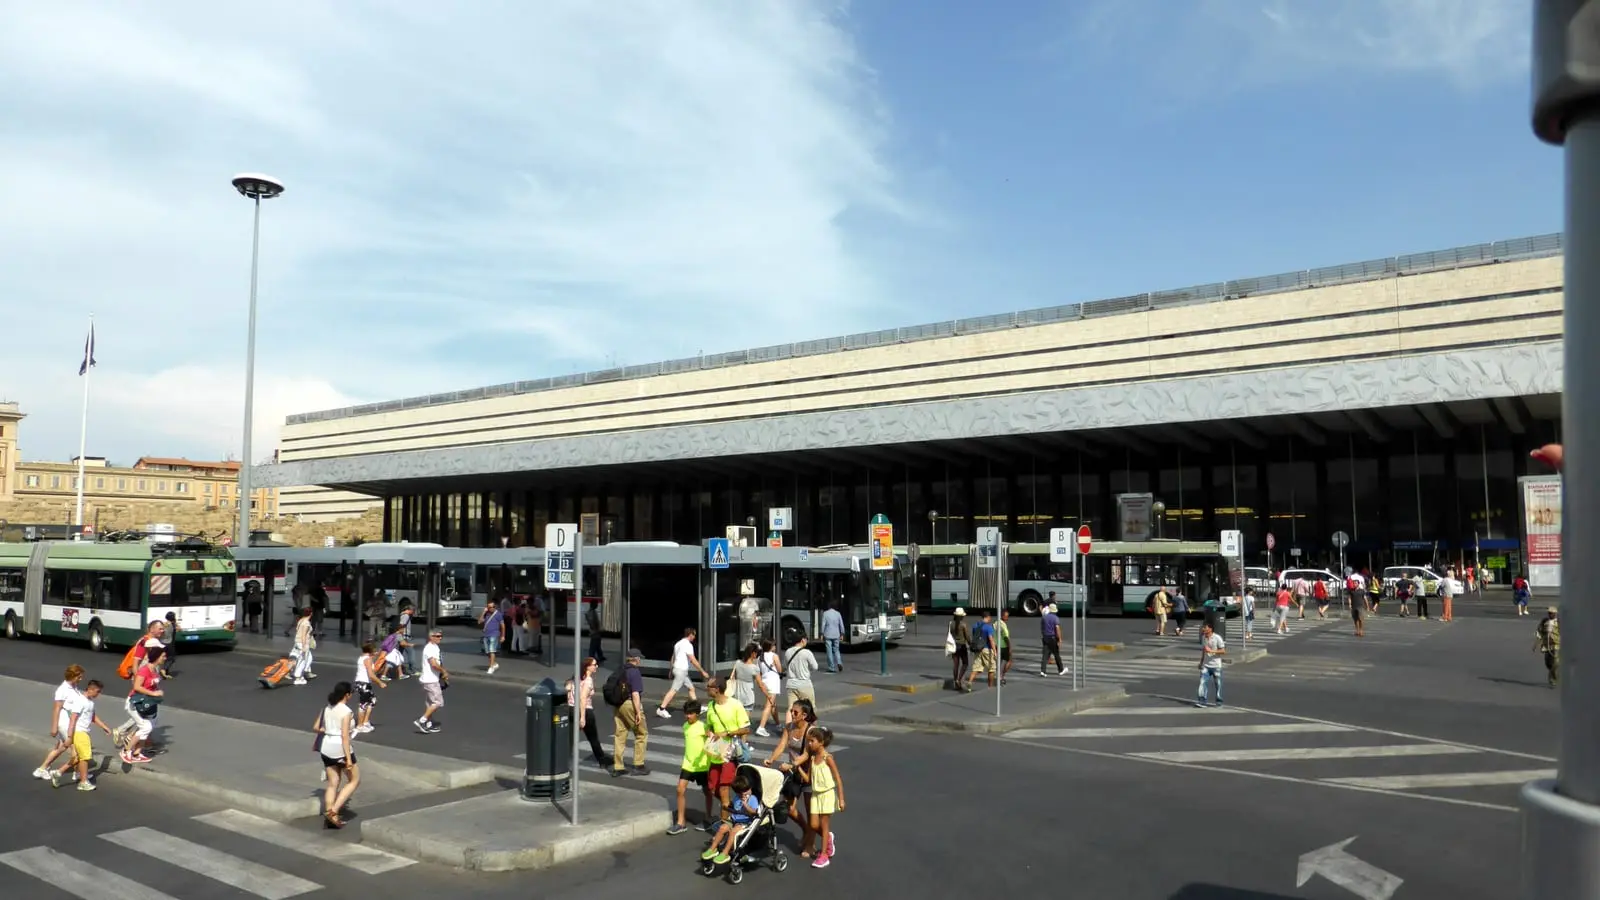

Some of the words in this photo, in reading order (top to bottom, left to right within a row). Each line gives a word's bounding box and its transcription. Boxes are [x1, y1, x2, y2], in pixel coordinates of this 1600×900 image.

[557, 528, 565, 546] D
[986, 529, 992, 541] C
[1058, 530, 1064, 541] B
[1227, 531, 1233, 540] A
[548, 559, 553, 568] 7
[562, 559, 570, 569] 13
